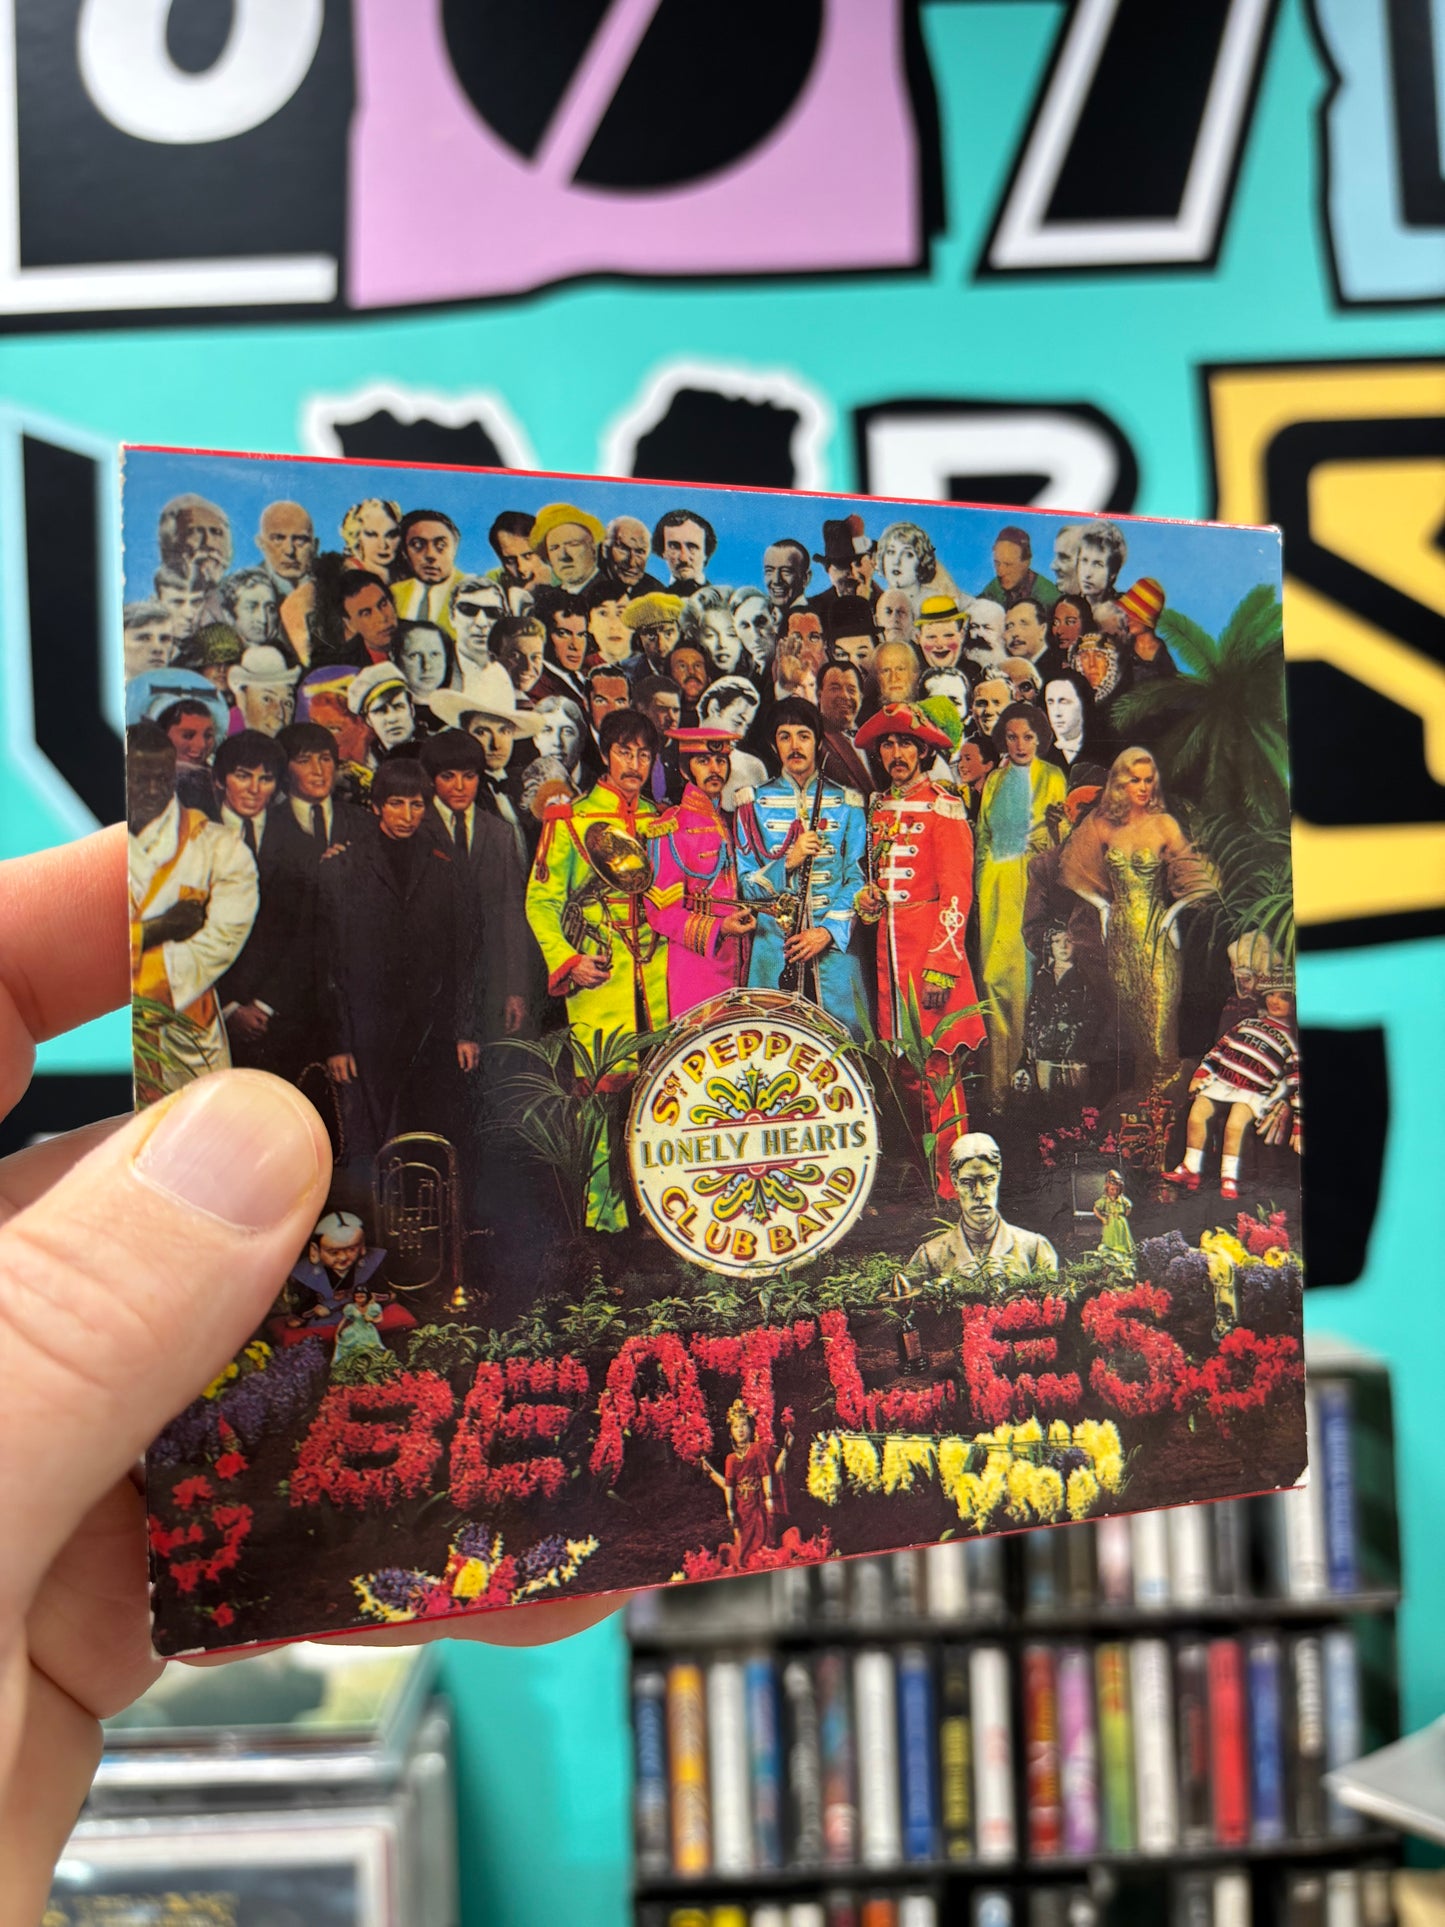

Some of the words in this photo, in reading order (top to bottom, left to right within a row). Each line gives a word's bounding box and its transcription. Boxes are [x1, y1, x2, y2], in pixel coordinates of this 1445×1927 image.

[681, 1029, 854, 1113] PEPPERS
[1243, 1034, 1269, 1053] THE
[641, 1132, 749, 1169] LONELY
[762, 1121, 867, 1156] HEARTS
[661, 1185, 757, 1260] CLUB
[768, 1166, 856, 1254] BAND
[289, 1280, 1186, 1510] BEATLES
